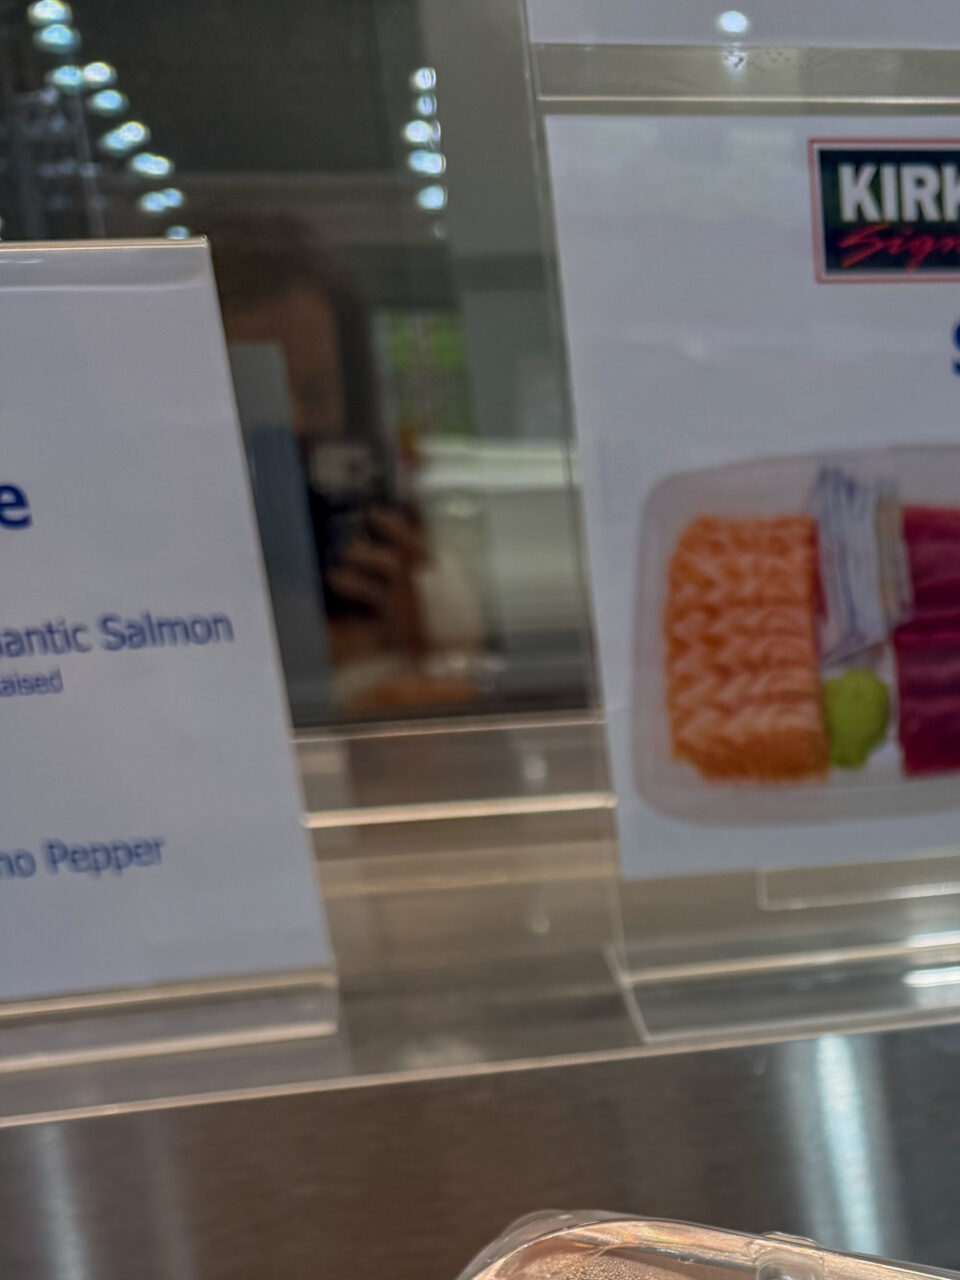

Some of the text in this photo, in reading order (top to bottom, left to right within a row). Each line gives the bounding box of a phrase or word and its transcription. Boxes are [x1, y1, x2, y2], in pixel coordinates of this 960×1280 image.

[98, 610, 234, 650] Salmon
[0, 668, 64, 696] aised
[43, 837, 165, 877] Pepper
